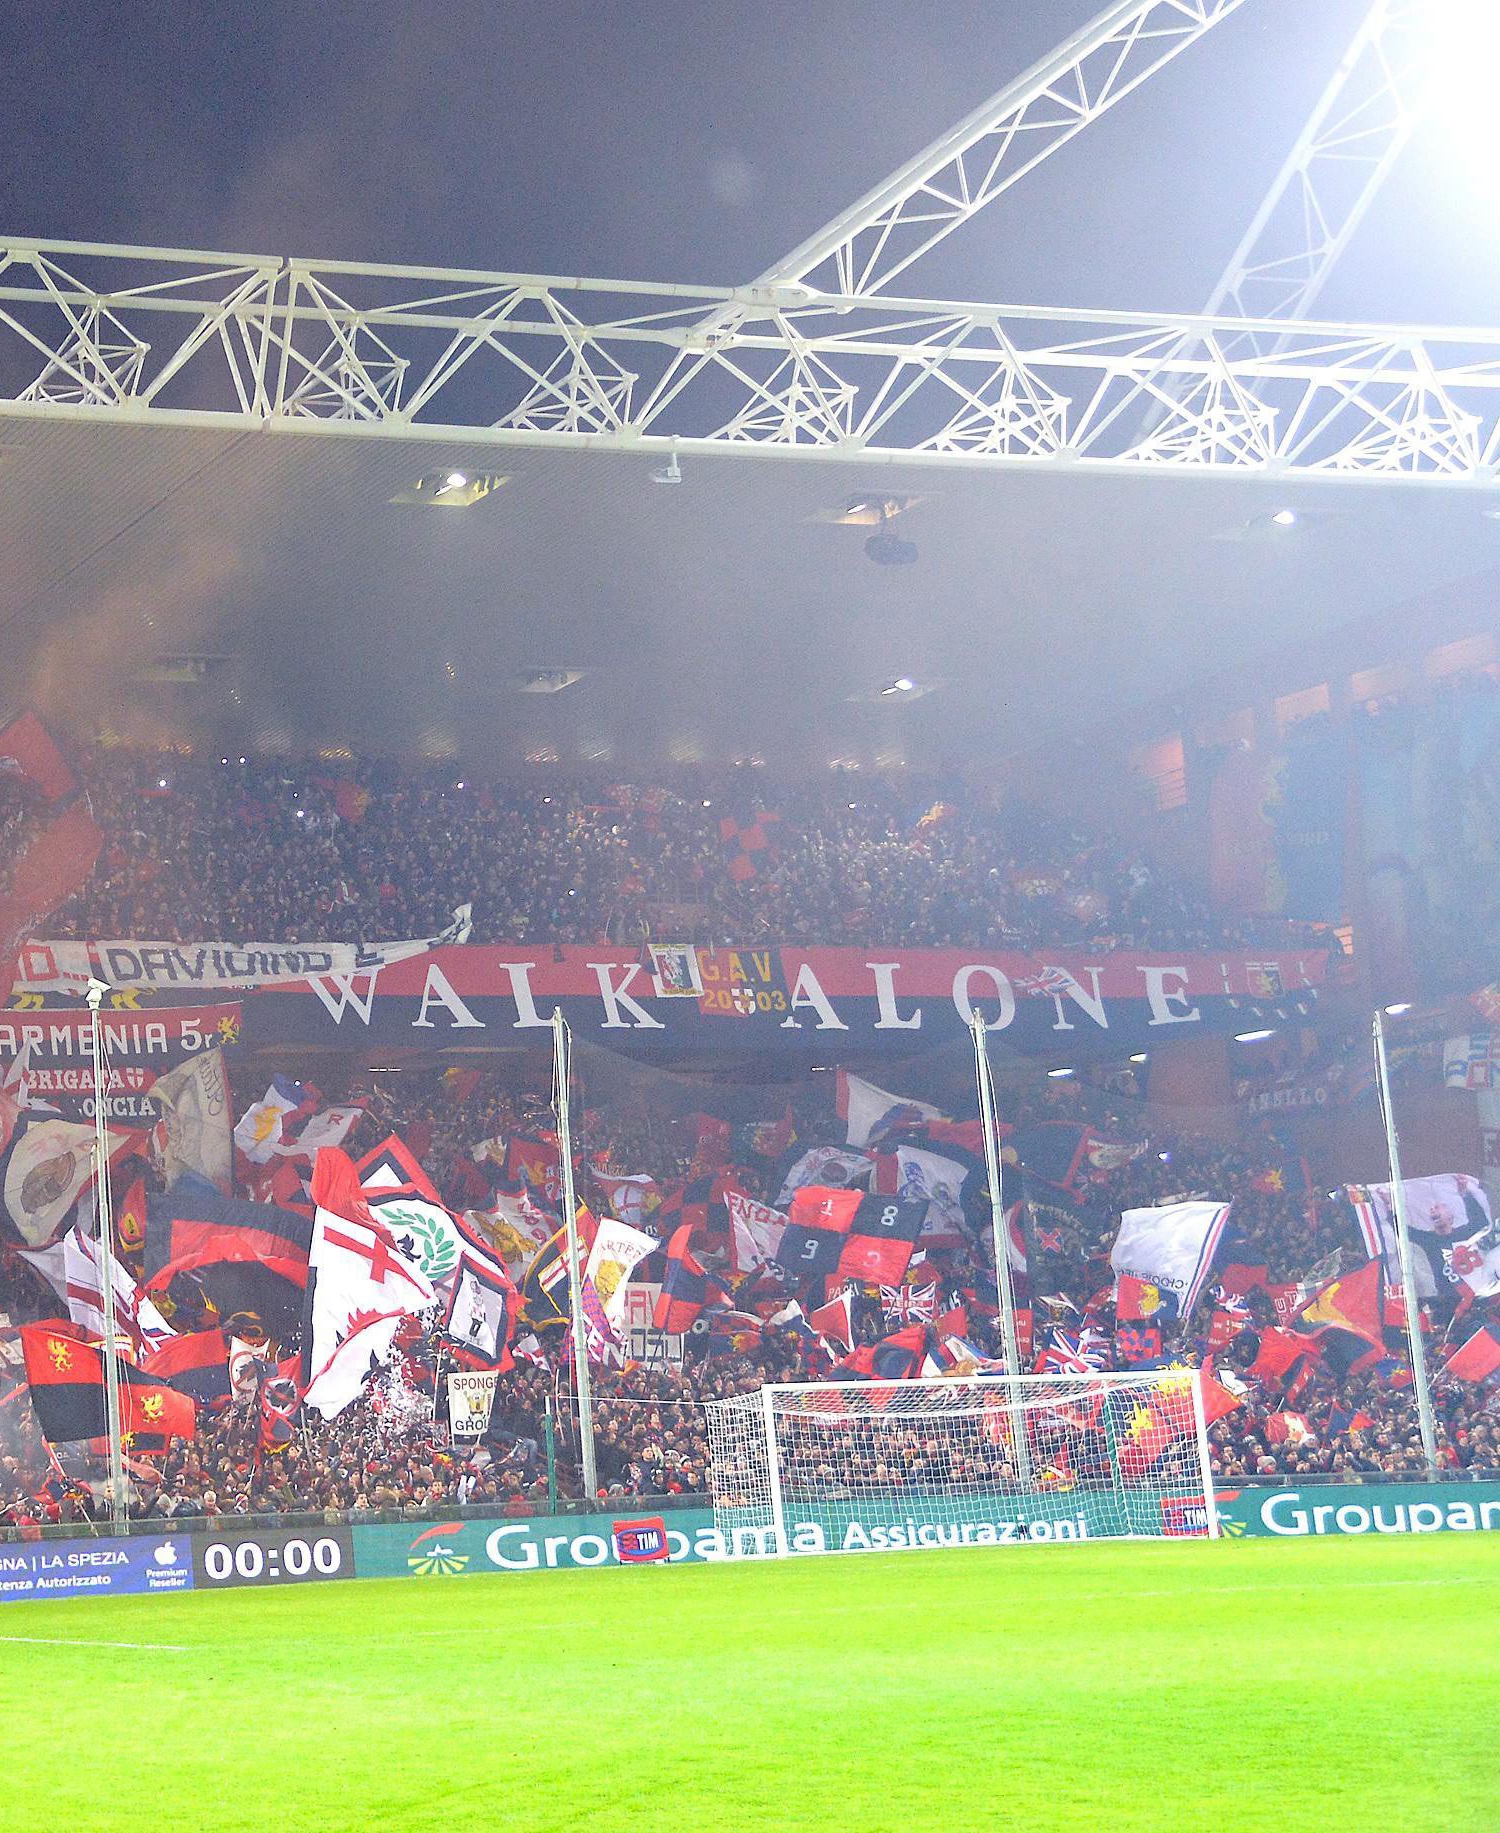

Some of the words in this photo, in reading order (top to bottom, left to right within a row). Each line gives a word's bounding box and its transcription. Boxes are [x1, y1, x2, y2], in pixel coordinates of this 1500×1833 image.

[300, 962, 666, 1028] WALK
[780, 962, 1200, 1029] ALONE
[842, 1511, 1088, 1550] Assicurazioni
[636, 1531, 659, 1550] TIM
[41, 1554, 63, 1570] LA
[67, 1551, 129, 1568] SPEZIA
[203, 1537, 342, 1580] 00:00
[37, 1573, 111, 1590] Autorizzato
[146, 1568, 188, 1579] Premium
[149, 1577, 186, 1588] Reseller
